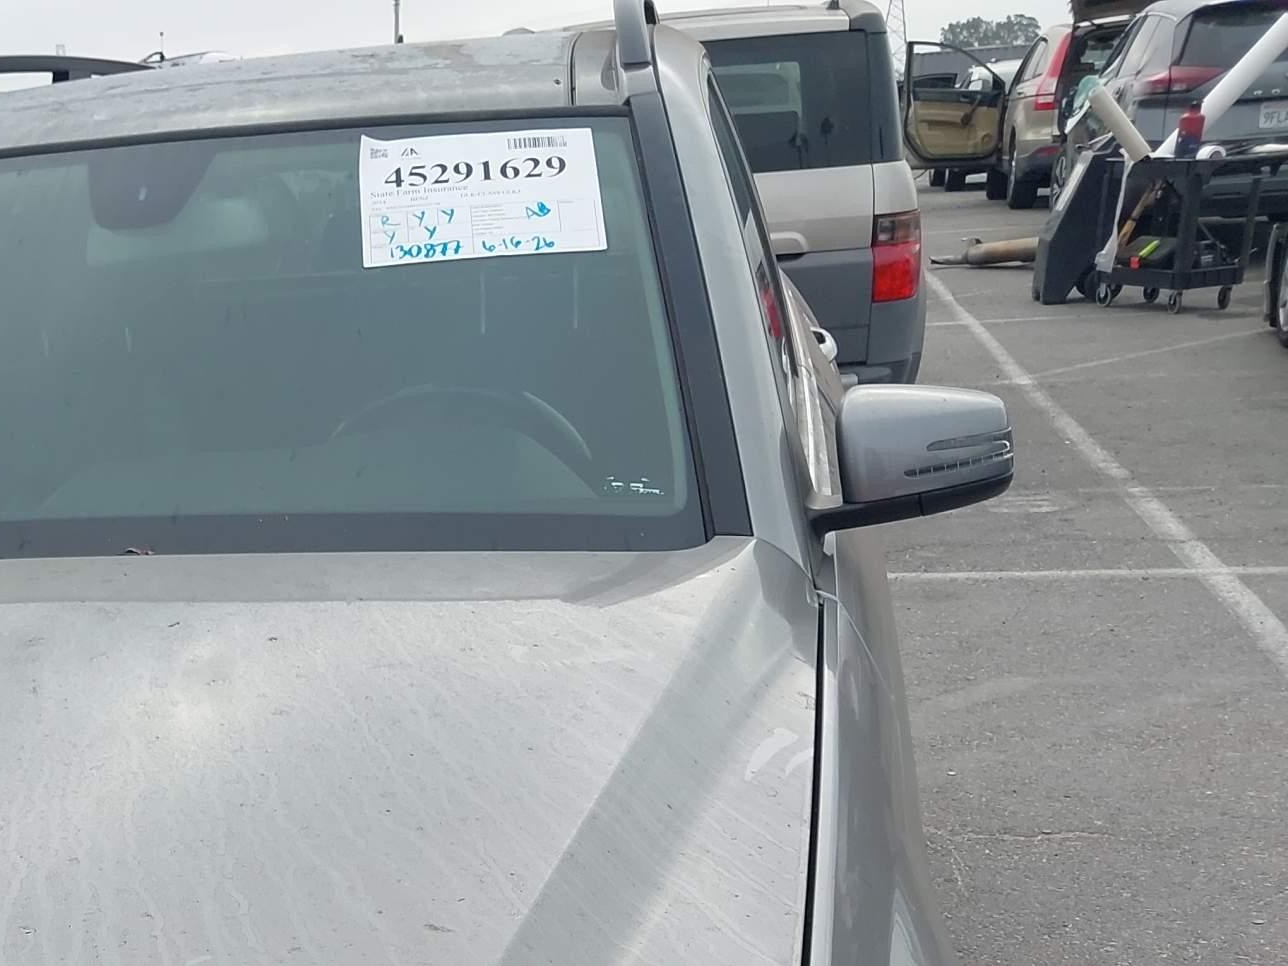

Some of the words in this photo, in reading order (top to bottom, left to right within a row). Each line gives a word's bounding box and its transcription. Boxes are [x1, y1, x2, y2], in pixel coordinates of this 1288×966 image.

[384, 155, 567, 188] 45291629
[370, 191, 393, 199] State
[396, 188, 421, 197] Farm
[424, 185, 469, 194] Insurance
